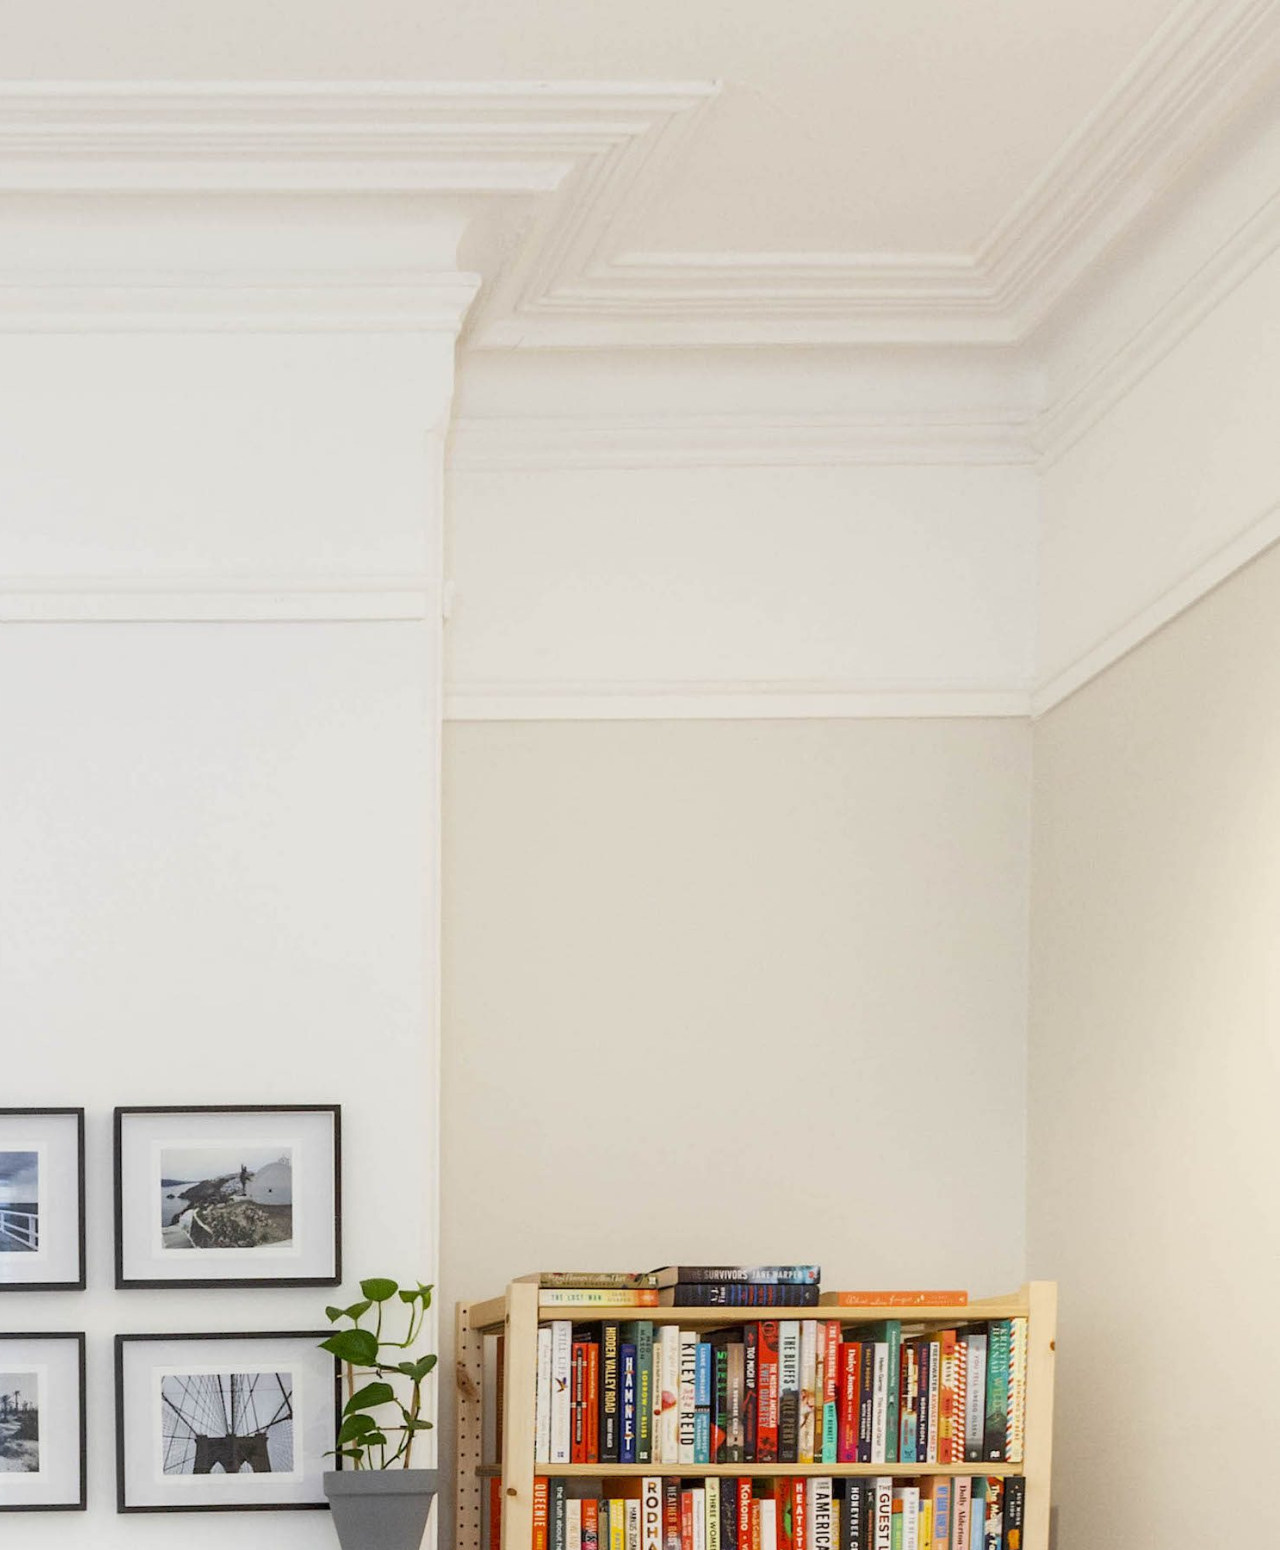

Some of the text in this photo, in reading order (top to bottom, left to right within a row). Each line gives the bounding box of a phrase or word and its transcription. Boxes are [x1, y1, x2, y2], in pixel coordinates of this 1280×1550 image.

[704, 1270, 748, 1280] SURVIVORS
[604, 1327, 616, 1413] HIDDEN VALLEY ROAD
[746, 1347, 755, 1378] TOO MUCH
[783, 1336, 796, 1384] THE BLUFFS
[827, 1341, 837, 1396] VANISHING HALF
[991, 1327, 1000, 1373] HANNAH
[999, 1328, 1008, 1372] KRISTIN
[681, 1343, 695, 1446] KILEY REID
[845, 1349, 856, 1400] Daisy Jones
[769, 1399, 777, 1428] AMERICAN
[534, 1484, 546, 1527] QUEENIE
[629, 1506, 638, 1532] MARKUS
[667, 1486, 677, 1523] HEATHER
[709, 1494, 717, 1518] THREE
[740, 1484, 750, 1531] Kokomo
[850, 1487, 859, 1536] HONEYBEE
[879, 1493, 890, 1541] GUEST
[957, 1485, 967, 1545] Dolly Alderton
